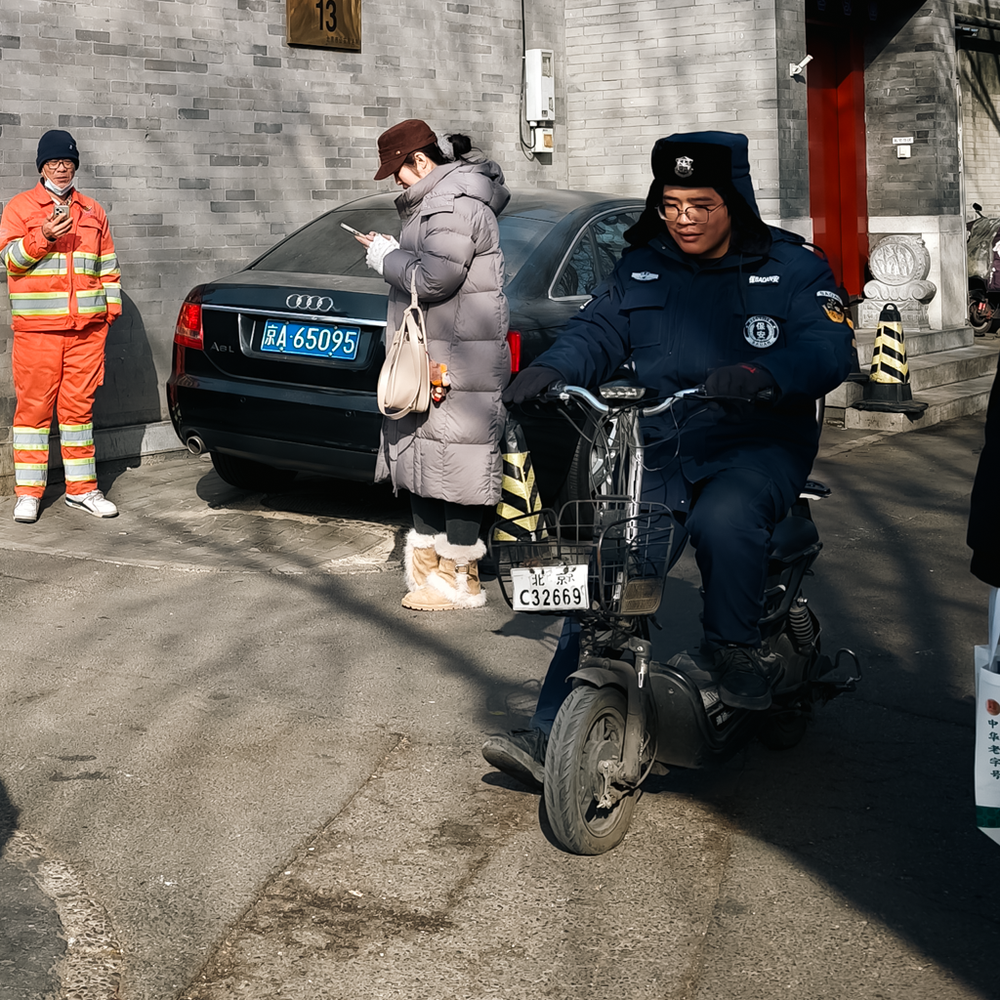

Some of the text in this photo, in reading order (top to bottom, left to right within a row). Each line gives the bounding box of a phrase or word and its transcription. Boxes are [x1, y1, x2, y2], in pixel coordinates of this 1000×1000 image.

[756, 322, 766, 339] 保安
[532, 573, 568, 586] 北京
[520, 588, 581, 606] C32669
[988, 719, 1000, 780] 中华老字号
